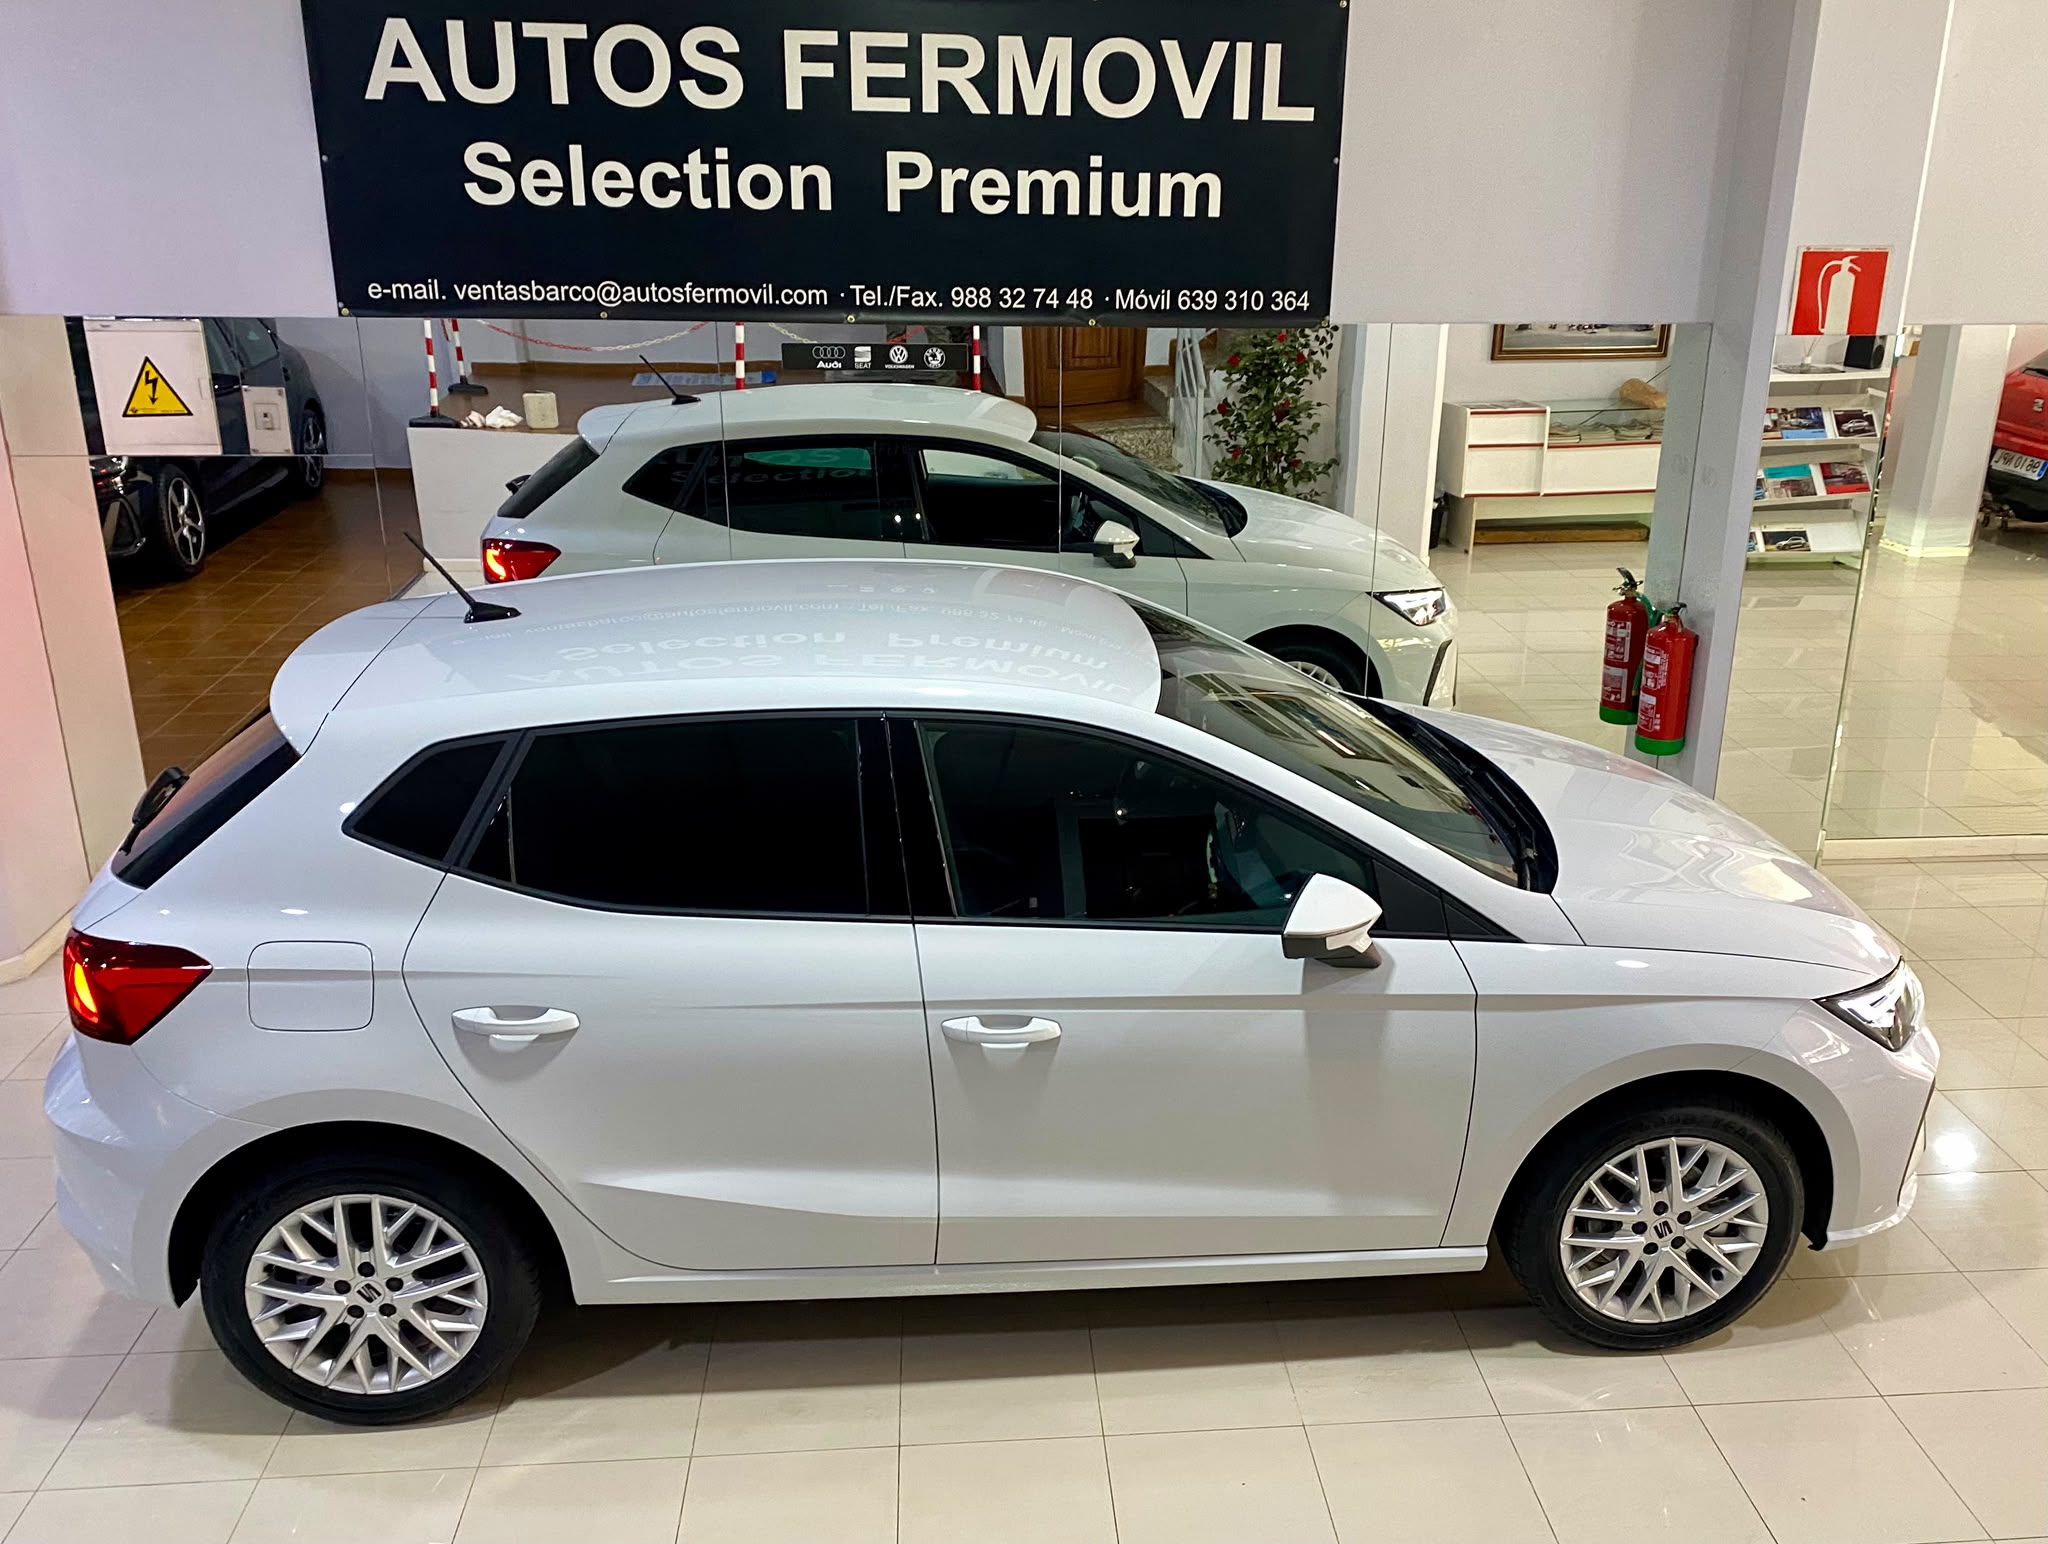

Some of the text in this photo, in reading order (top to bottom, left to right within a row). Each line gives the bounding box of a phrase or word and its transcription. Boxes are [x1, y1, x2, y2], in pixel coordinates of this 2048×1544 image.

[364, 17, 1315, 122] AUTOS FERMOVIL
[463, 141, 1222, 218] Selection Premium
[367, 278, 1310, 311] e-mail. ventasbarco@autosfermovil.com Tel./Fax. 988 32 74 48 Móvil 639 310 364
[816, 360, 842, 369] Audi
